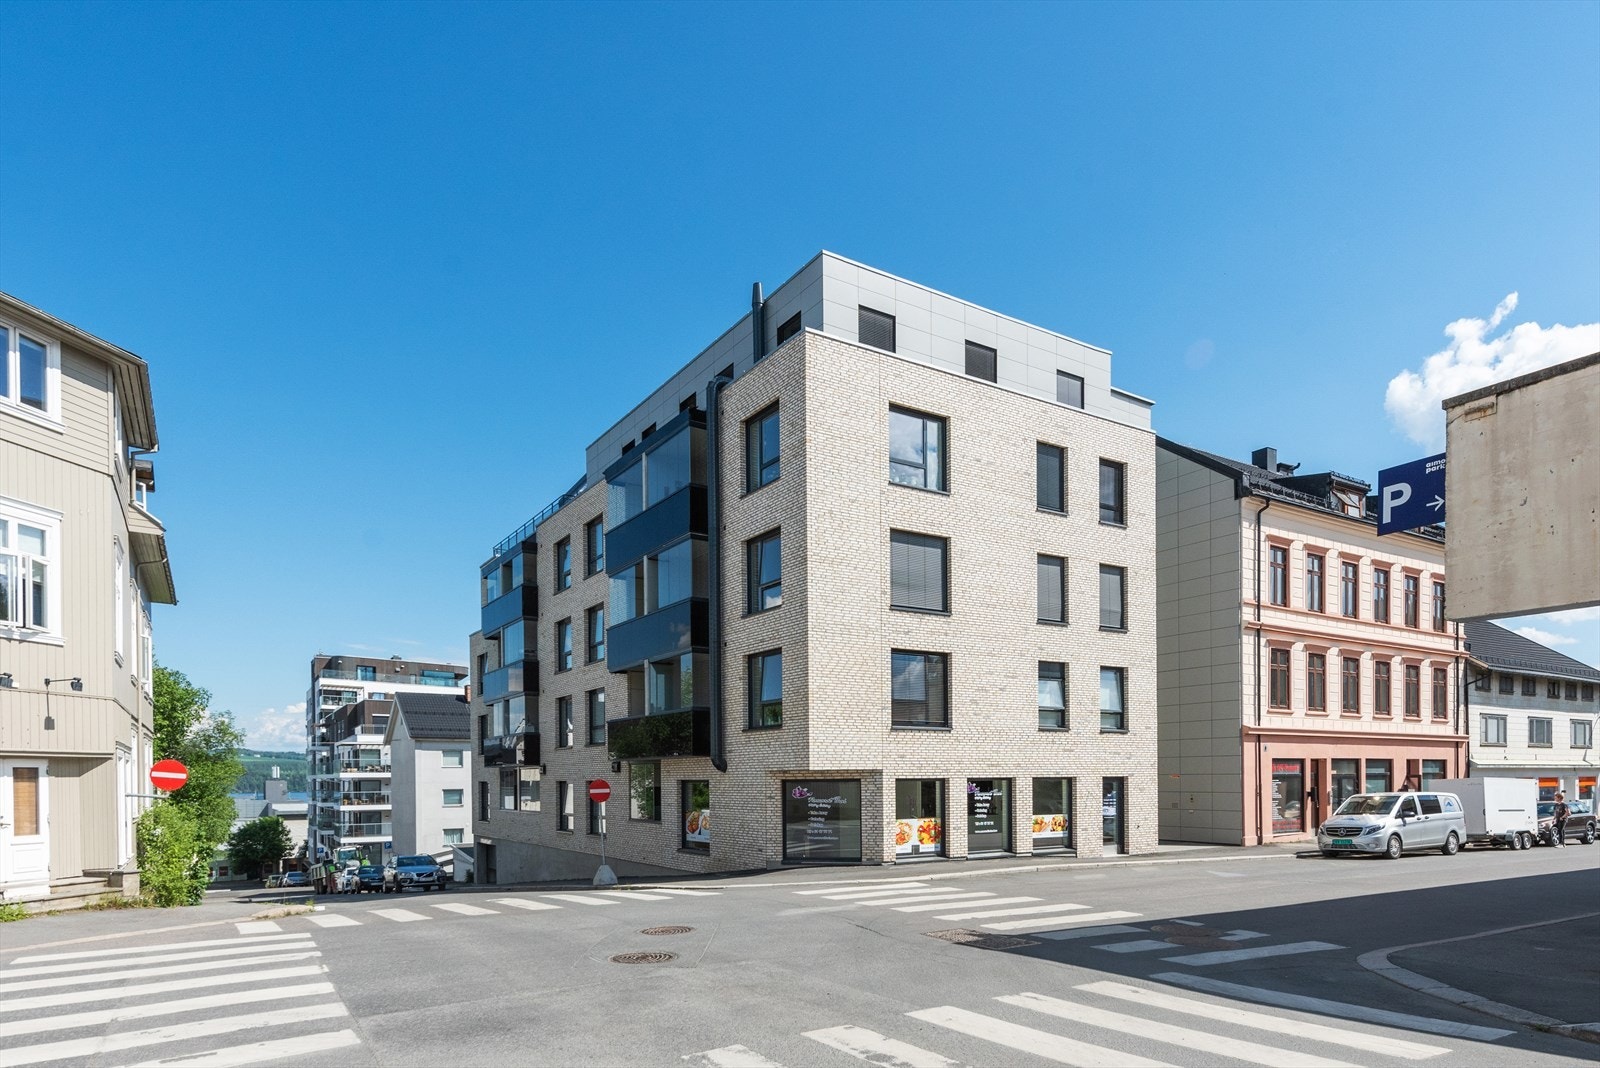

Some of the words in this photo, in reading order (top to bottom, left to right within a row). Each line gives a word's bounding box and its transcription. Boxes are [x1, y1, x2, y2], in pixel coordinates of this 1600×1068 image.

[1426, 459, 1446, 468] aimo
[1426, 464, 1446, 474] park
[1383, 482, 1412, 524] P
